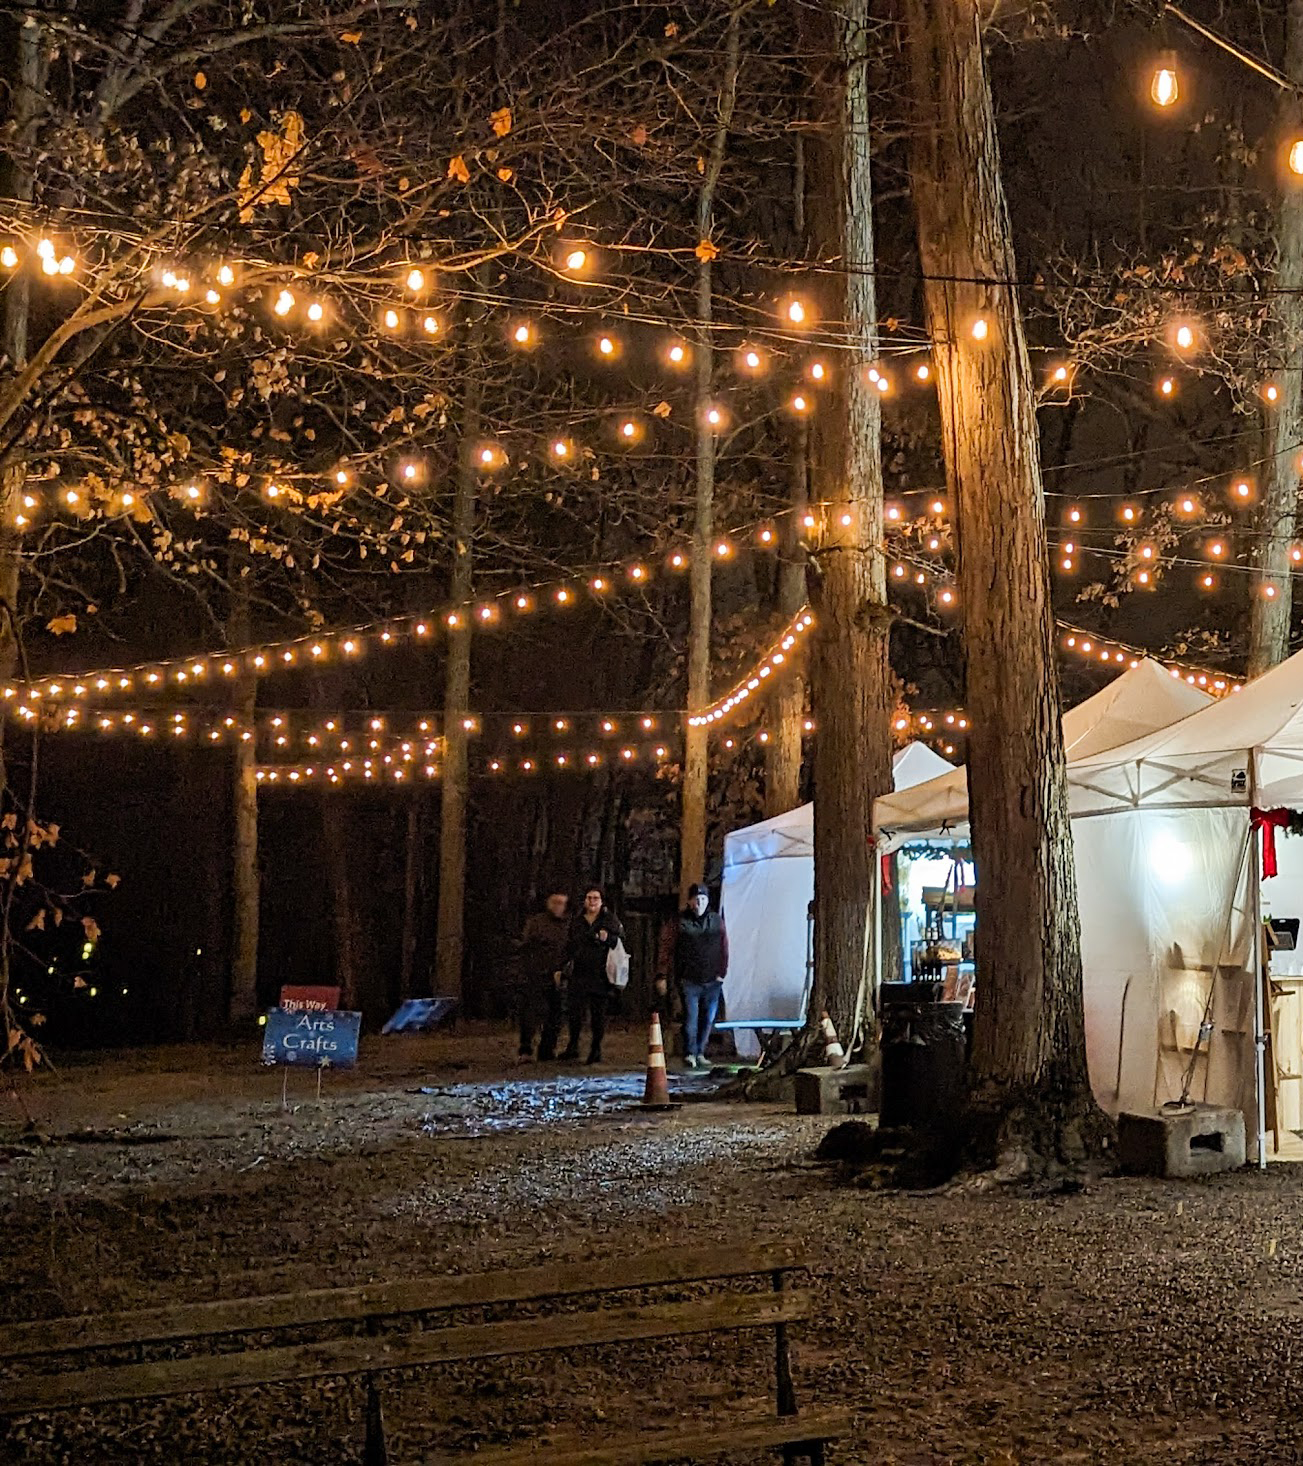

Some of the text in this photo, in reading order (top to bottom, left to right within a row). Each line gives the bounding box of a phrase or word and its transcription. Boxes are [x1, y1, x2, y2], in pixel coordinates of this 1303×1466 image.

[283, 998, 304, 1009] This
[295, 1014, 335, 1032] Arts
[282, 1033, 338, 1054] Crafts
